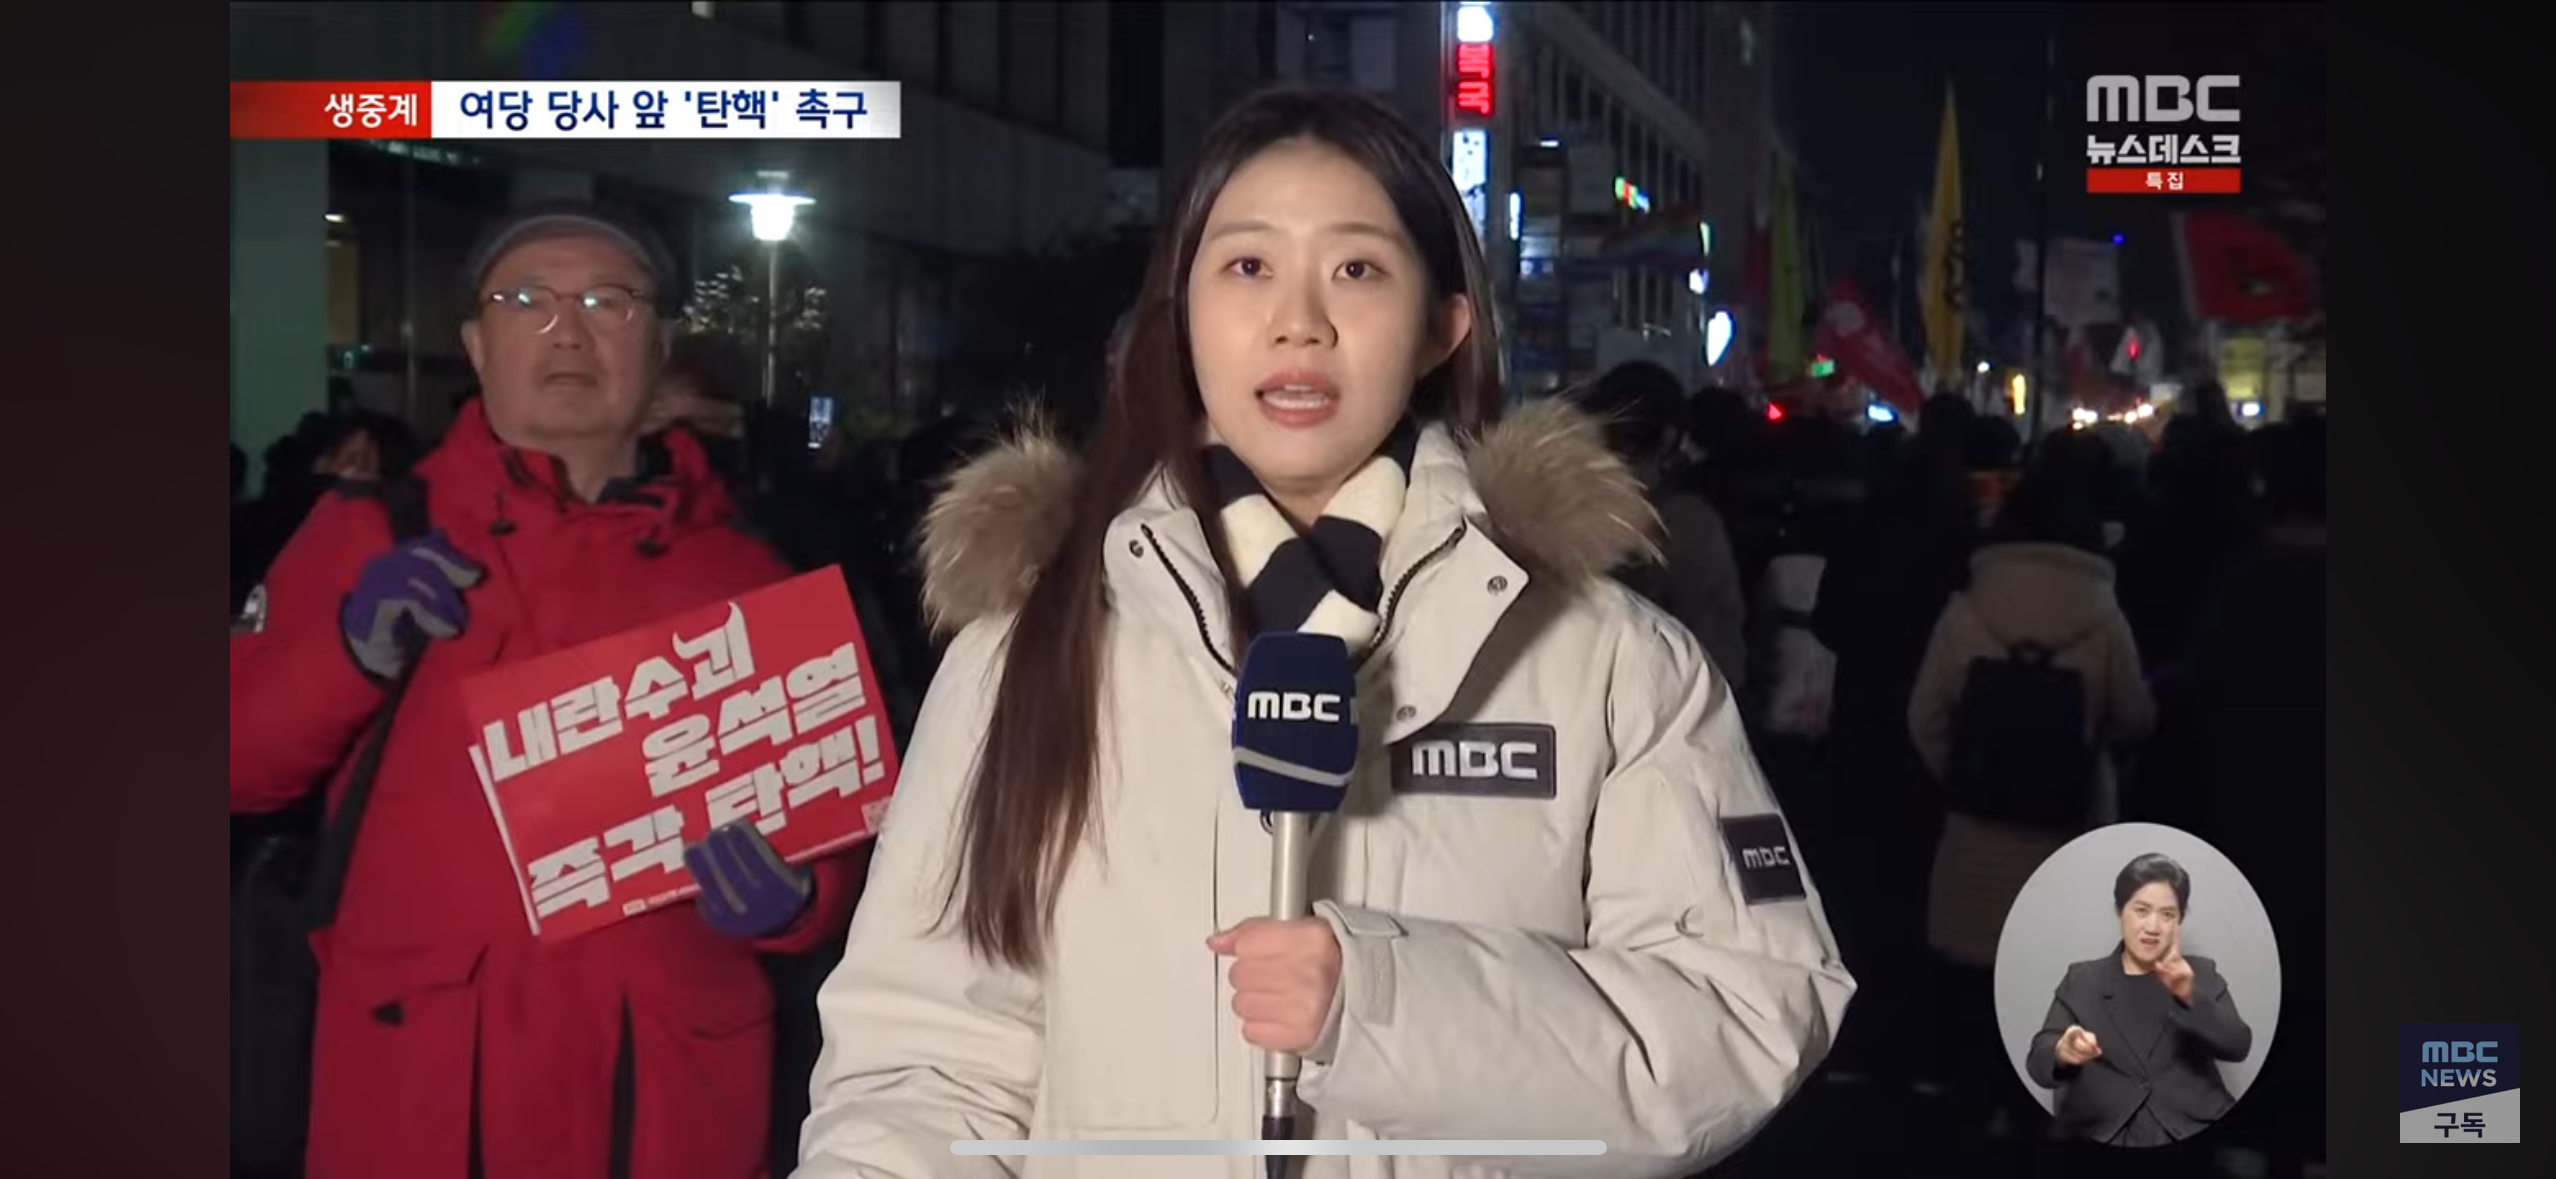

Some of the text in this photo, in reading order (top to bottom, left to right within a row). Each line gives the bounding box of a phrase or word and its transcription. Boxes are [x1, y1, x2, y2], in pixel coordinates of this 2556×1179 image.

[483, 601, 754, 782] 내란수괴
[642, 642, 866, 798] 윤석열
[1247, 691, 1341, 722] MBC
[1411, 740, 1537, 780] MBC
[528, 715, 885, 918] 즉각 탄핵!
